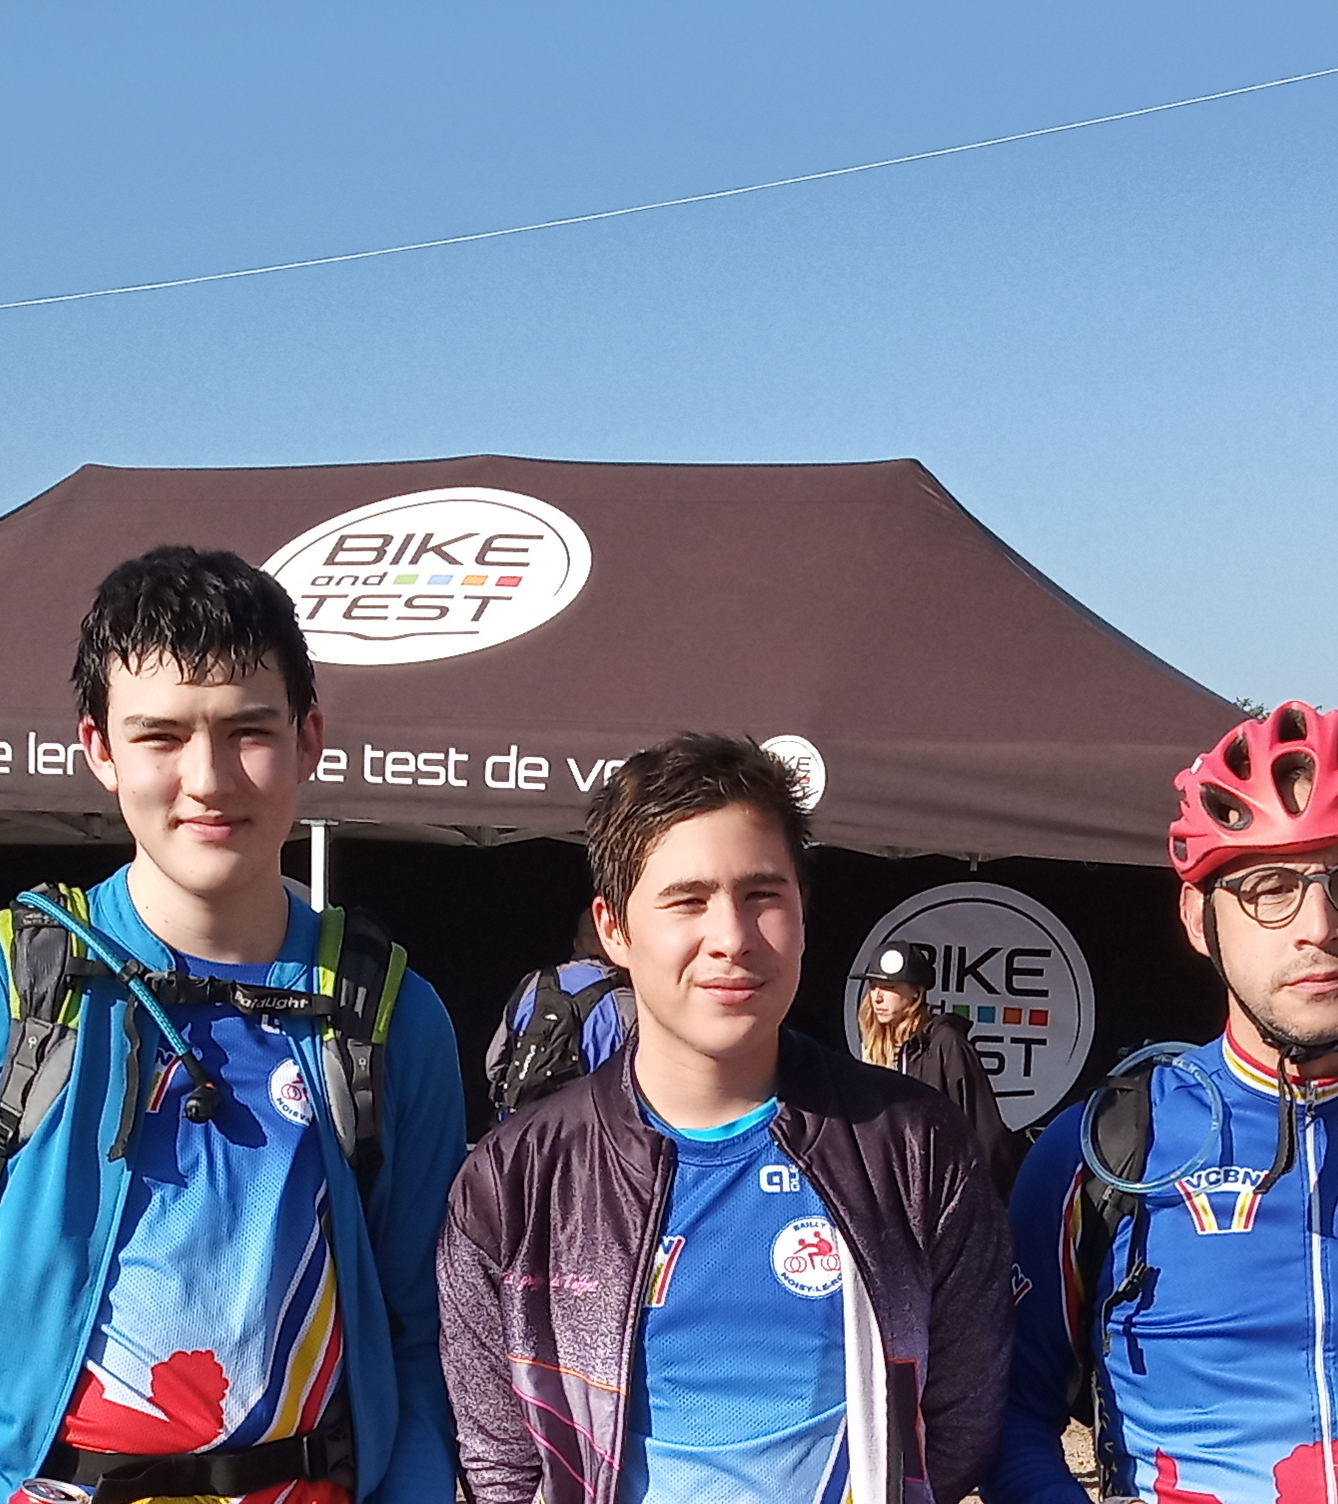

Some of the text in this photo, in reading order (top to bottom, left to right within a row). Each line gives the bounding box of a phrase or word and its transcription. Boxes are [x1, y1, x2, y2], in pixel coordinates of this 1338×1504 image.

[322, 532, 544, 568] BIKE
[310, 571, 388, 586] and
[301, 594, 513, 622] TEST
[363, 744, 468, 787] test
[485, 745, 549, 791] de
[969, 1035, 1048, 1078] ST
[1184, 1168, 1262, 1189] VCBN
[780, 1272, 842, 1292] NOISY-LE-RO
